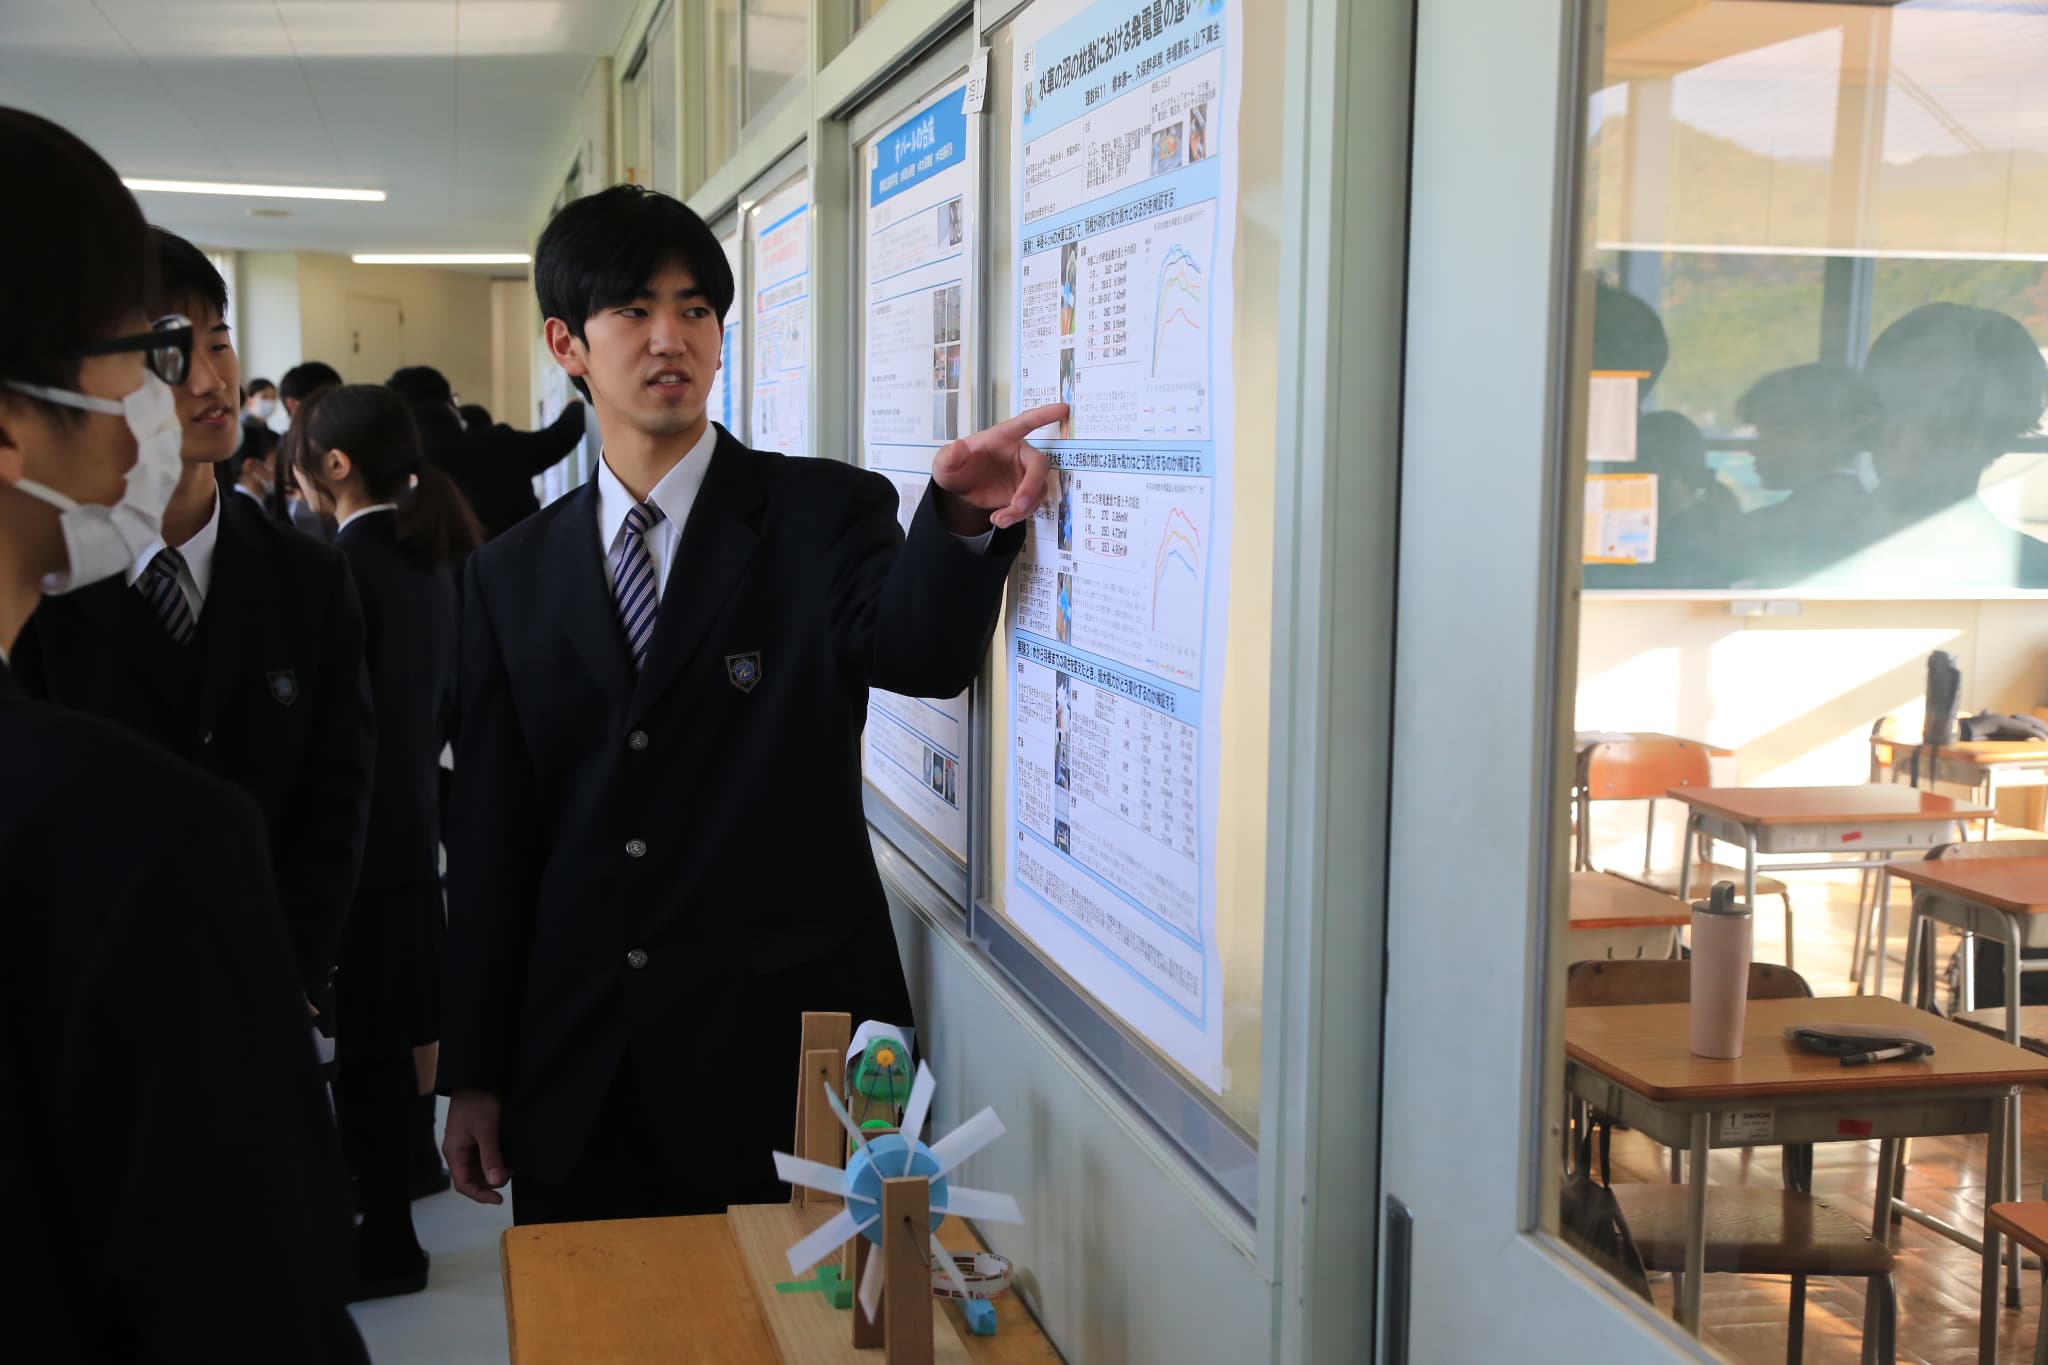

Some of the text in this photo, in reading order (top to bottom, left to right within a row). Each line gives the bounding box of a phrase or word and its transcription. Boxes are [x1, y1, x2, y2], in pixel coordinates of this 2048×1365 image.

[895, 115, 935, 164] オパールの合成
